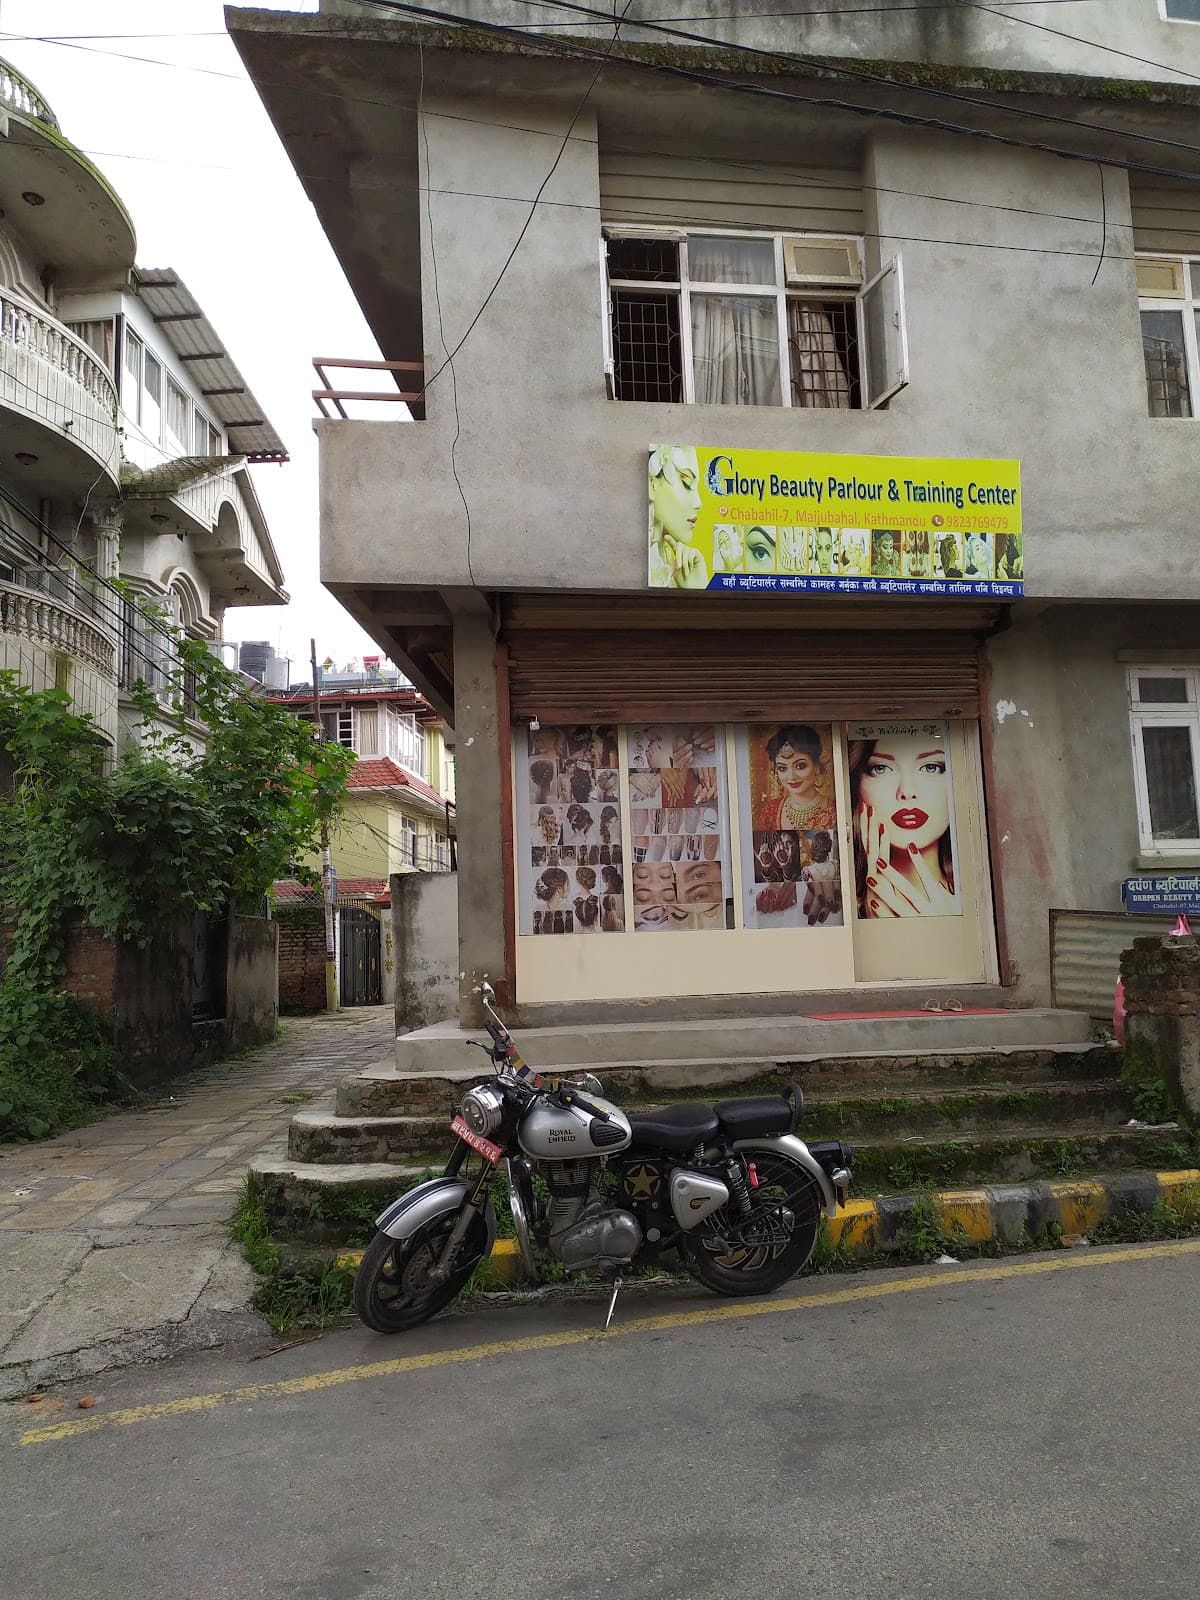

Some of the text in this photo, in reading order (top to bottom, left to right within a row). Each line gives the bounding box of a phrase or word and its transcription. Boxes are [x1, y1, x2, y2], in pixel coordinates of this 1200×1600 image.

[705, 456, 1016, 508] Glory Beauty Parlour & Training Center
[730, 507, 1008, 529] Chabahil-7, Maijubahal, Kathmandu 9823769479
[949, 582, 972, 593] तालिम
[1127, 877, 1152, 891] दर्पण
[1163, 893, 1193, 901] BEAUTY
[548, 1135, 576, 1144] ENFIELD
